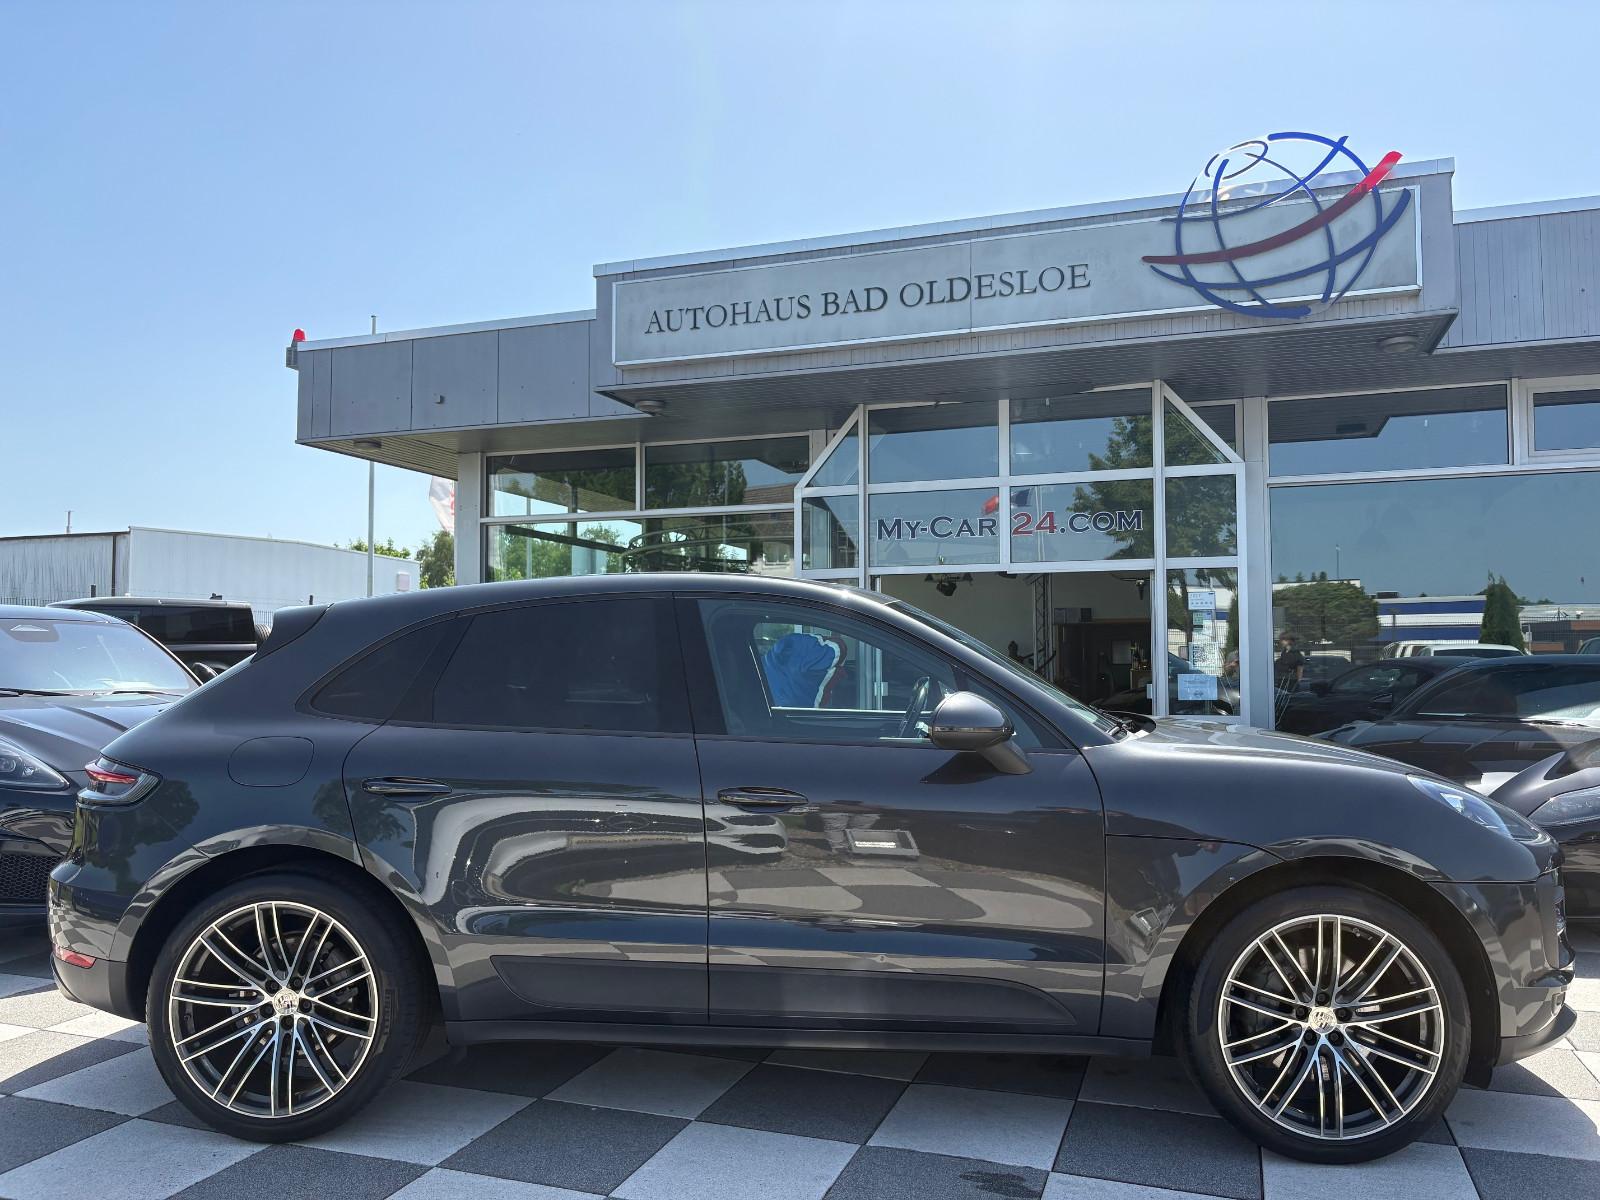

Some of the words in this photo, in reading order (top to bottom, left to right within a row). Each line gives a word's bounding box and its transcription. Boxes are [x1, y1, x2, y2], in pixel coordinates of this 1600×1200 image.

[644, 294, 812, 335] AUTOHAUS
[821, 286, 889, 317] BAD
[899, 263, 1092, 309] OLDESLOE
